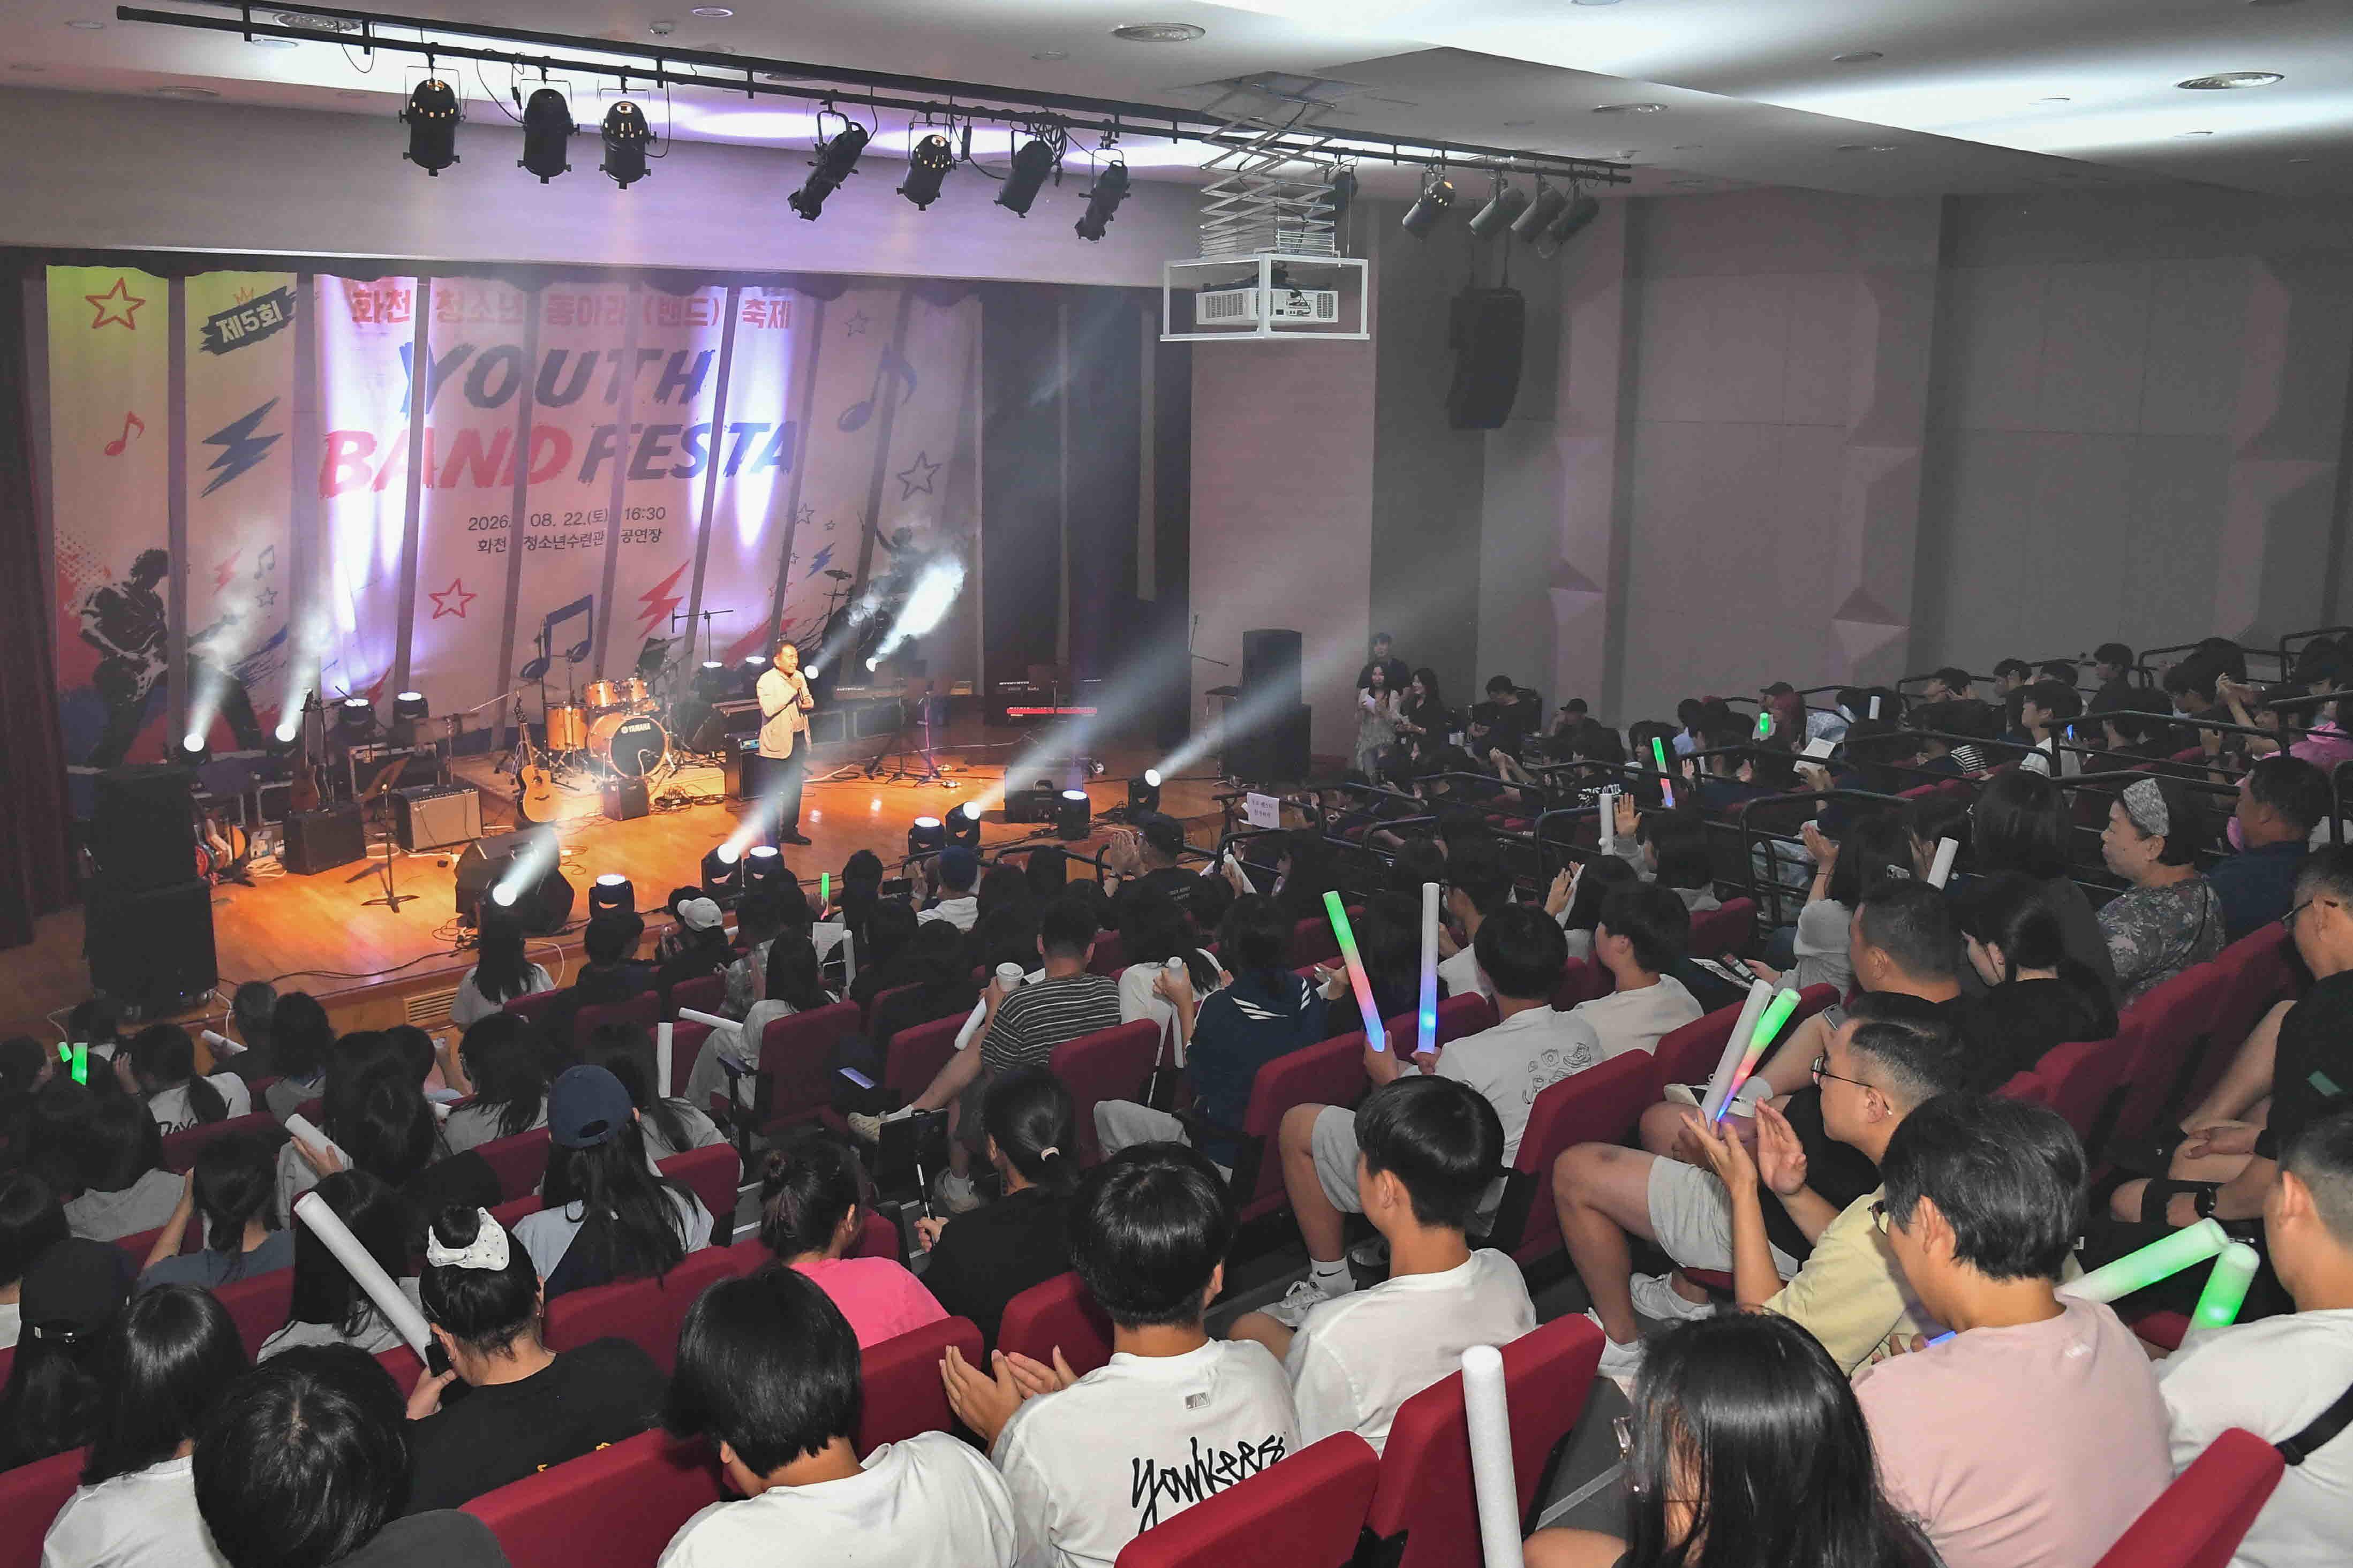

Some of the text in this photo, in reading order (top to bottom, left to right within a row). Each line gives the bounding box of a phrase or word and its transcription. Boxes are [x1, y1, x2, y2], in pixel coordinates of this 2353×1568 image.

[215, 300, 283, 343] 제5회
[351, 290, 410, 323] 화천
[644, 296, 720, 325] (밴드)
[742, 299, 791, 328] 축제
[399, 342, 716, 420] YOUTH
[318, 421, 797, 499] BAND FESTA
[530, 513, 556, 527] 08.
[625, 506, 666, 521] 16:30
[477, 528, 662, 554] 화천 청소년수련관 공연장
